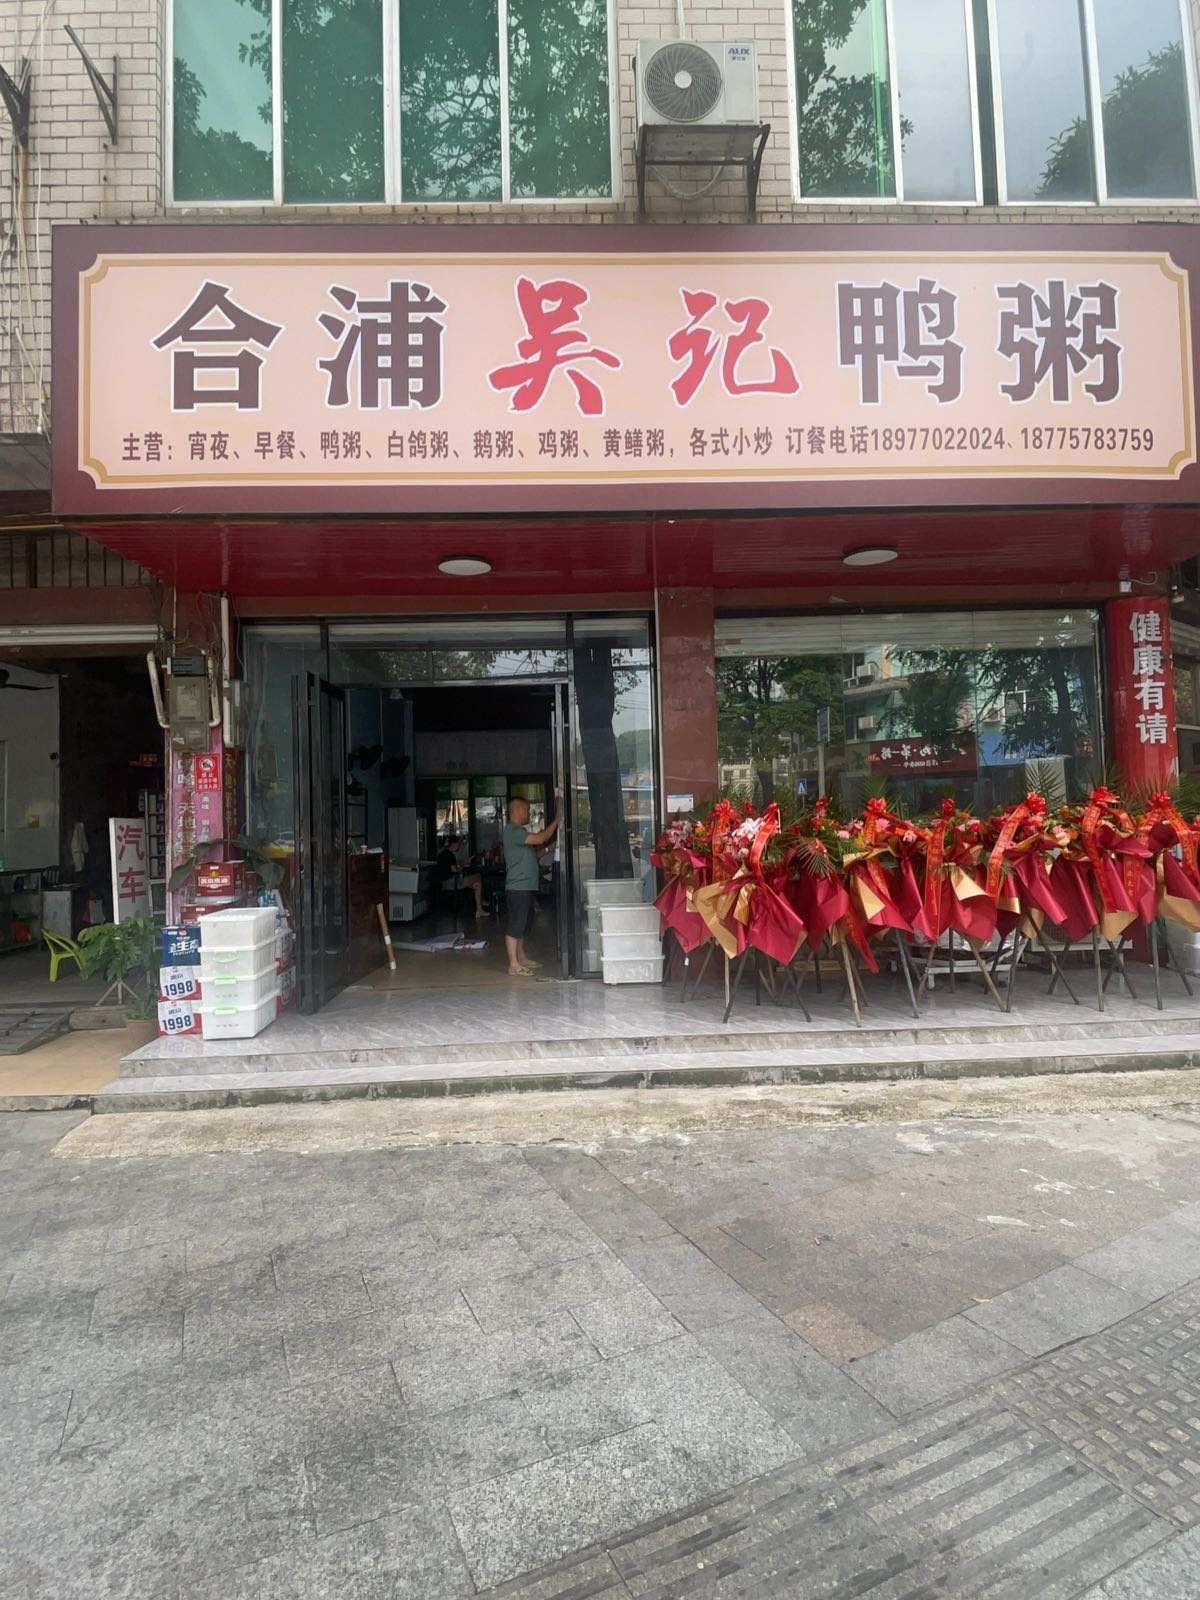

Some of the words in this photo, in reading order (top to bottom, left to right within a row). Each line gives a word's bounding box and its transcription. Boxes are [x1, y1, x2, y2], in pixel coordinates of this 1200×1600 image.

[152, 275, 1122, 414] 合浦吴记鸭粥
[1129, 611, 1168, 744] 健康有请
[117, 825, 147, 904] 汽车
[162, 1014, 192, 1031] 1998
[164, 980, 193, 996] 1998
